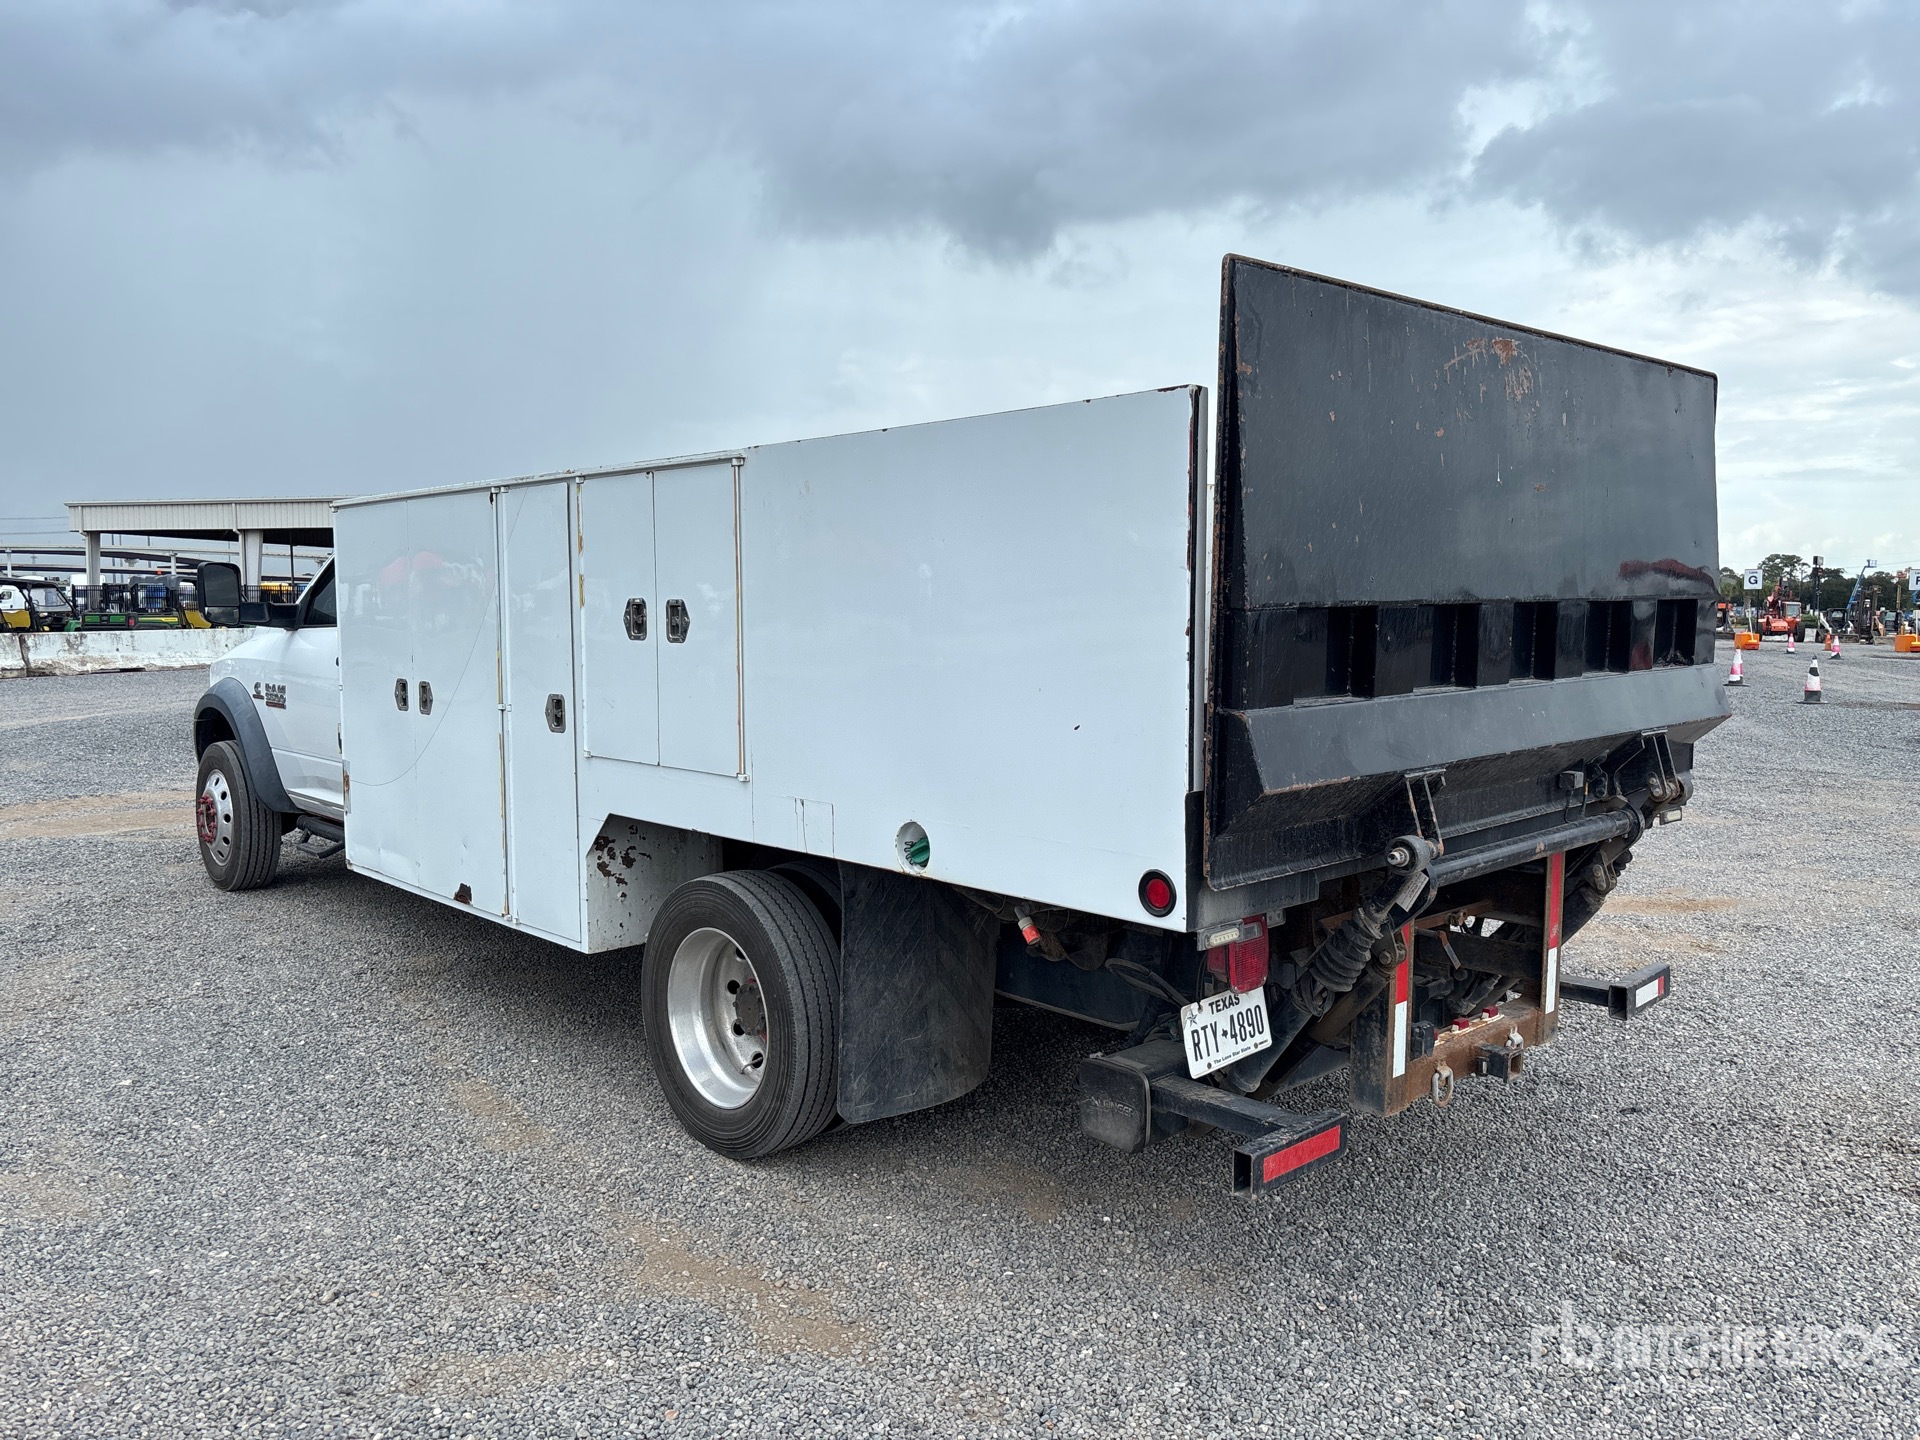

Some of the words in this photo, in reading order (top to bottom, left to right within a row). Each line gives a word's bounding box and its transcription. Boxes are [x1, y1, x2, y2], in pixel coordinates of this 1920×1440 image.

[1748, 575, 1758, 585] G
[1208, 994, 1241, 1015] TEXAS
[1191, 1021, 1220, 1062] RTY
[1229, 1004, 1265, 1045] 4890
[1221, 1054, 1232, 1062] Lone
[1232, 1050, 1241, 1058] Star
